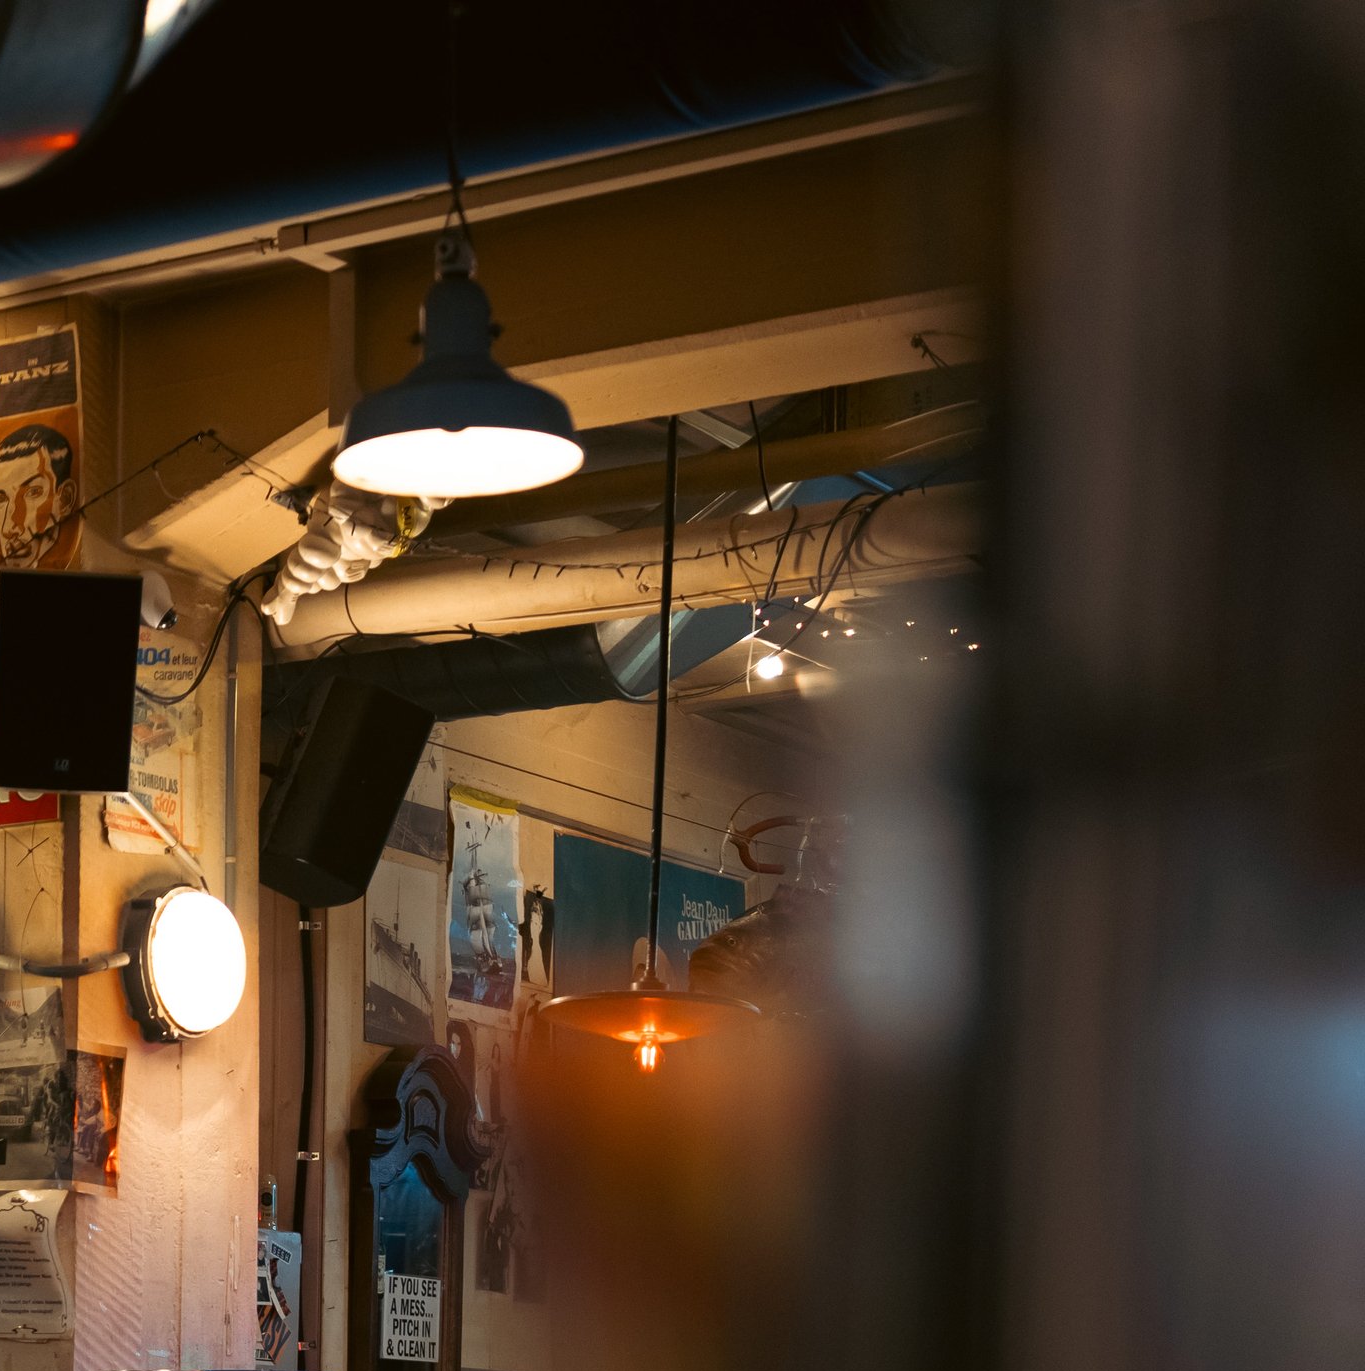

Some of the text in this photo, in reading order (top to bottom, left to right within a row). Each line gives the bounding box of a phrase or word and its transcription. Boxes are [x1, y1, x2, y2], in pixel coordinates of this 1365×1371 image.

[172, 655, 181, 665] et
[181, 654, 198, 666] leur
[682, 893, 730, 922] Jean Paul
[389, 1277, 437, 1297] IF YOU SEE
[390, 1298, 433, 1318] A MESS...
[393, 1318, 431, 1338] PITCH IN
[386, 1339, 436, 1359] & CLEAN IT
